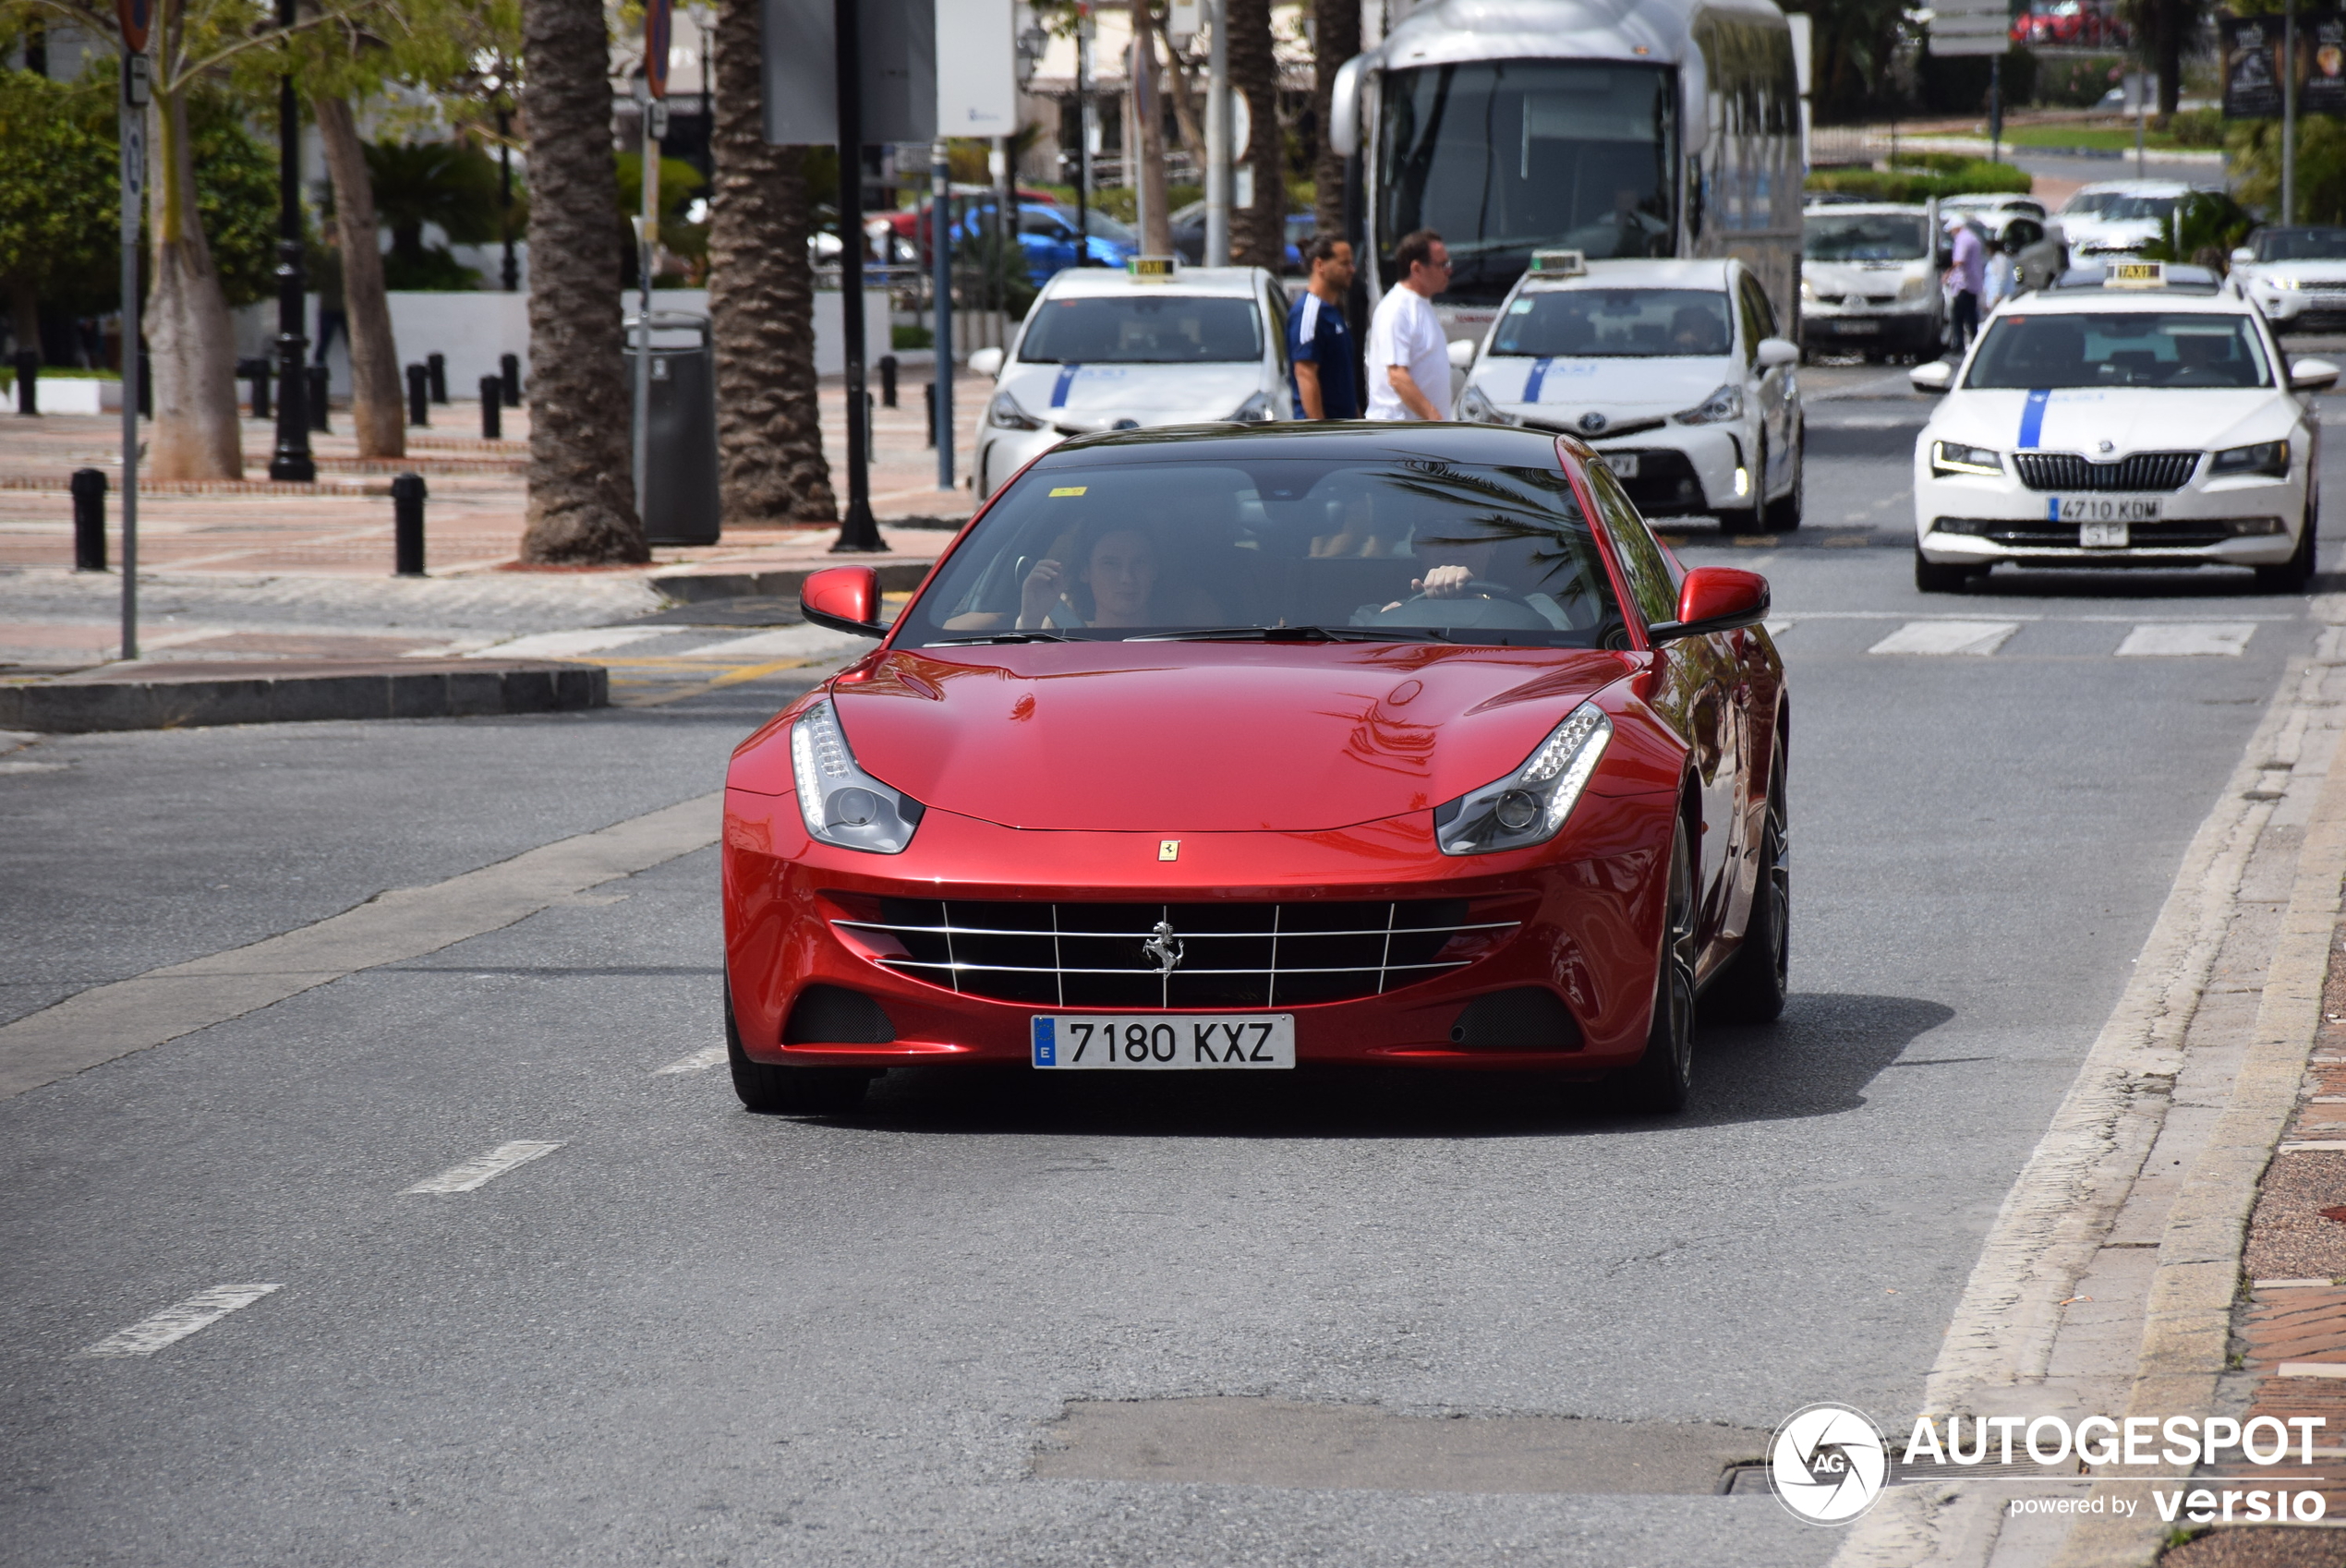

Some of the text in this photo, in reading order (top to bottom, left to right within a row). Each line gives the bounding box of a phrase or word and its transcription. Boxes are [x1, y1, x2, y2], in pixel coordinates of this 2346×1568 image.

[2120, 264, 2148, 279] TAXI
[2062, 501, 2112, 518] 4710
[2086, 523, 2121, 543] SP
[1040, 1022, 1274, 1063] E 7180 KXZ
